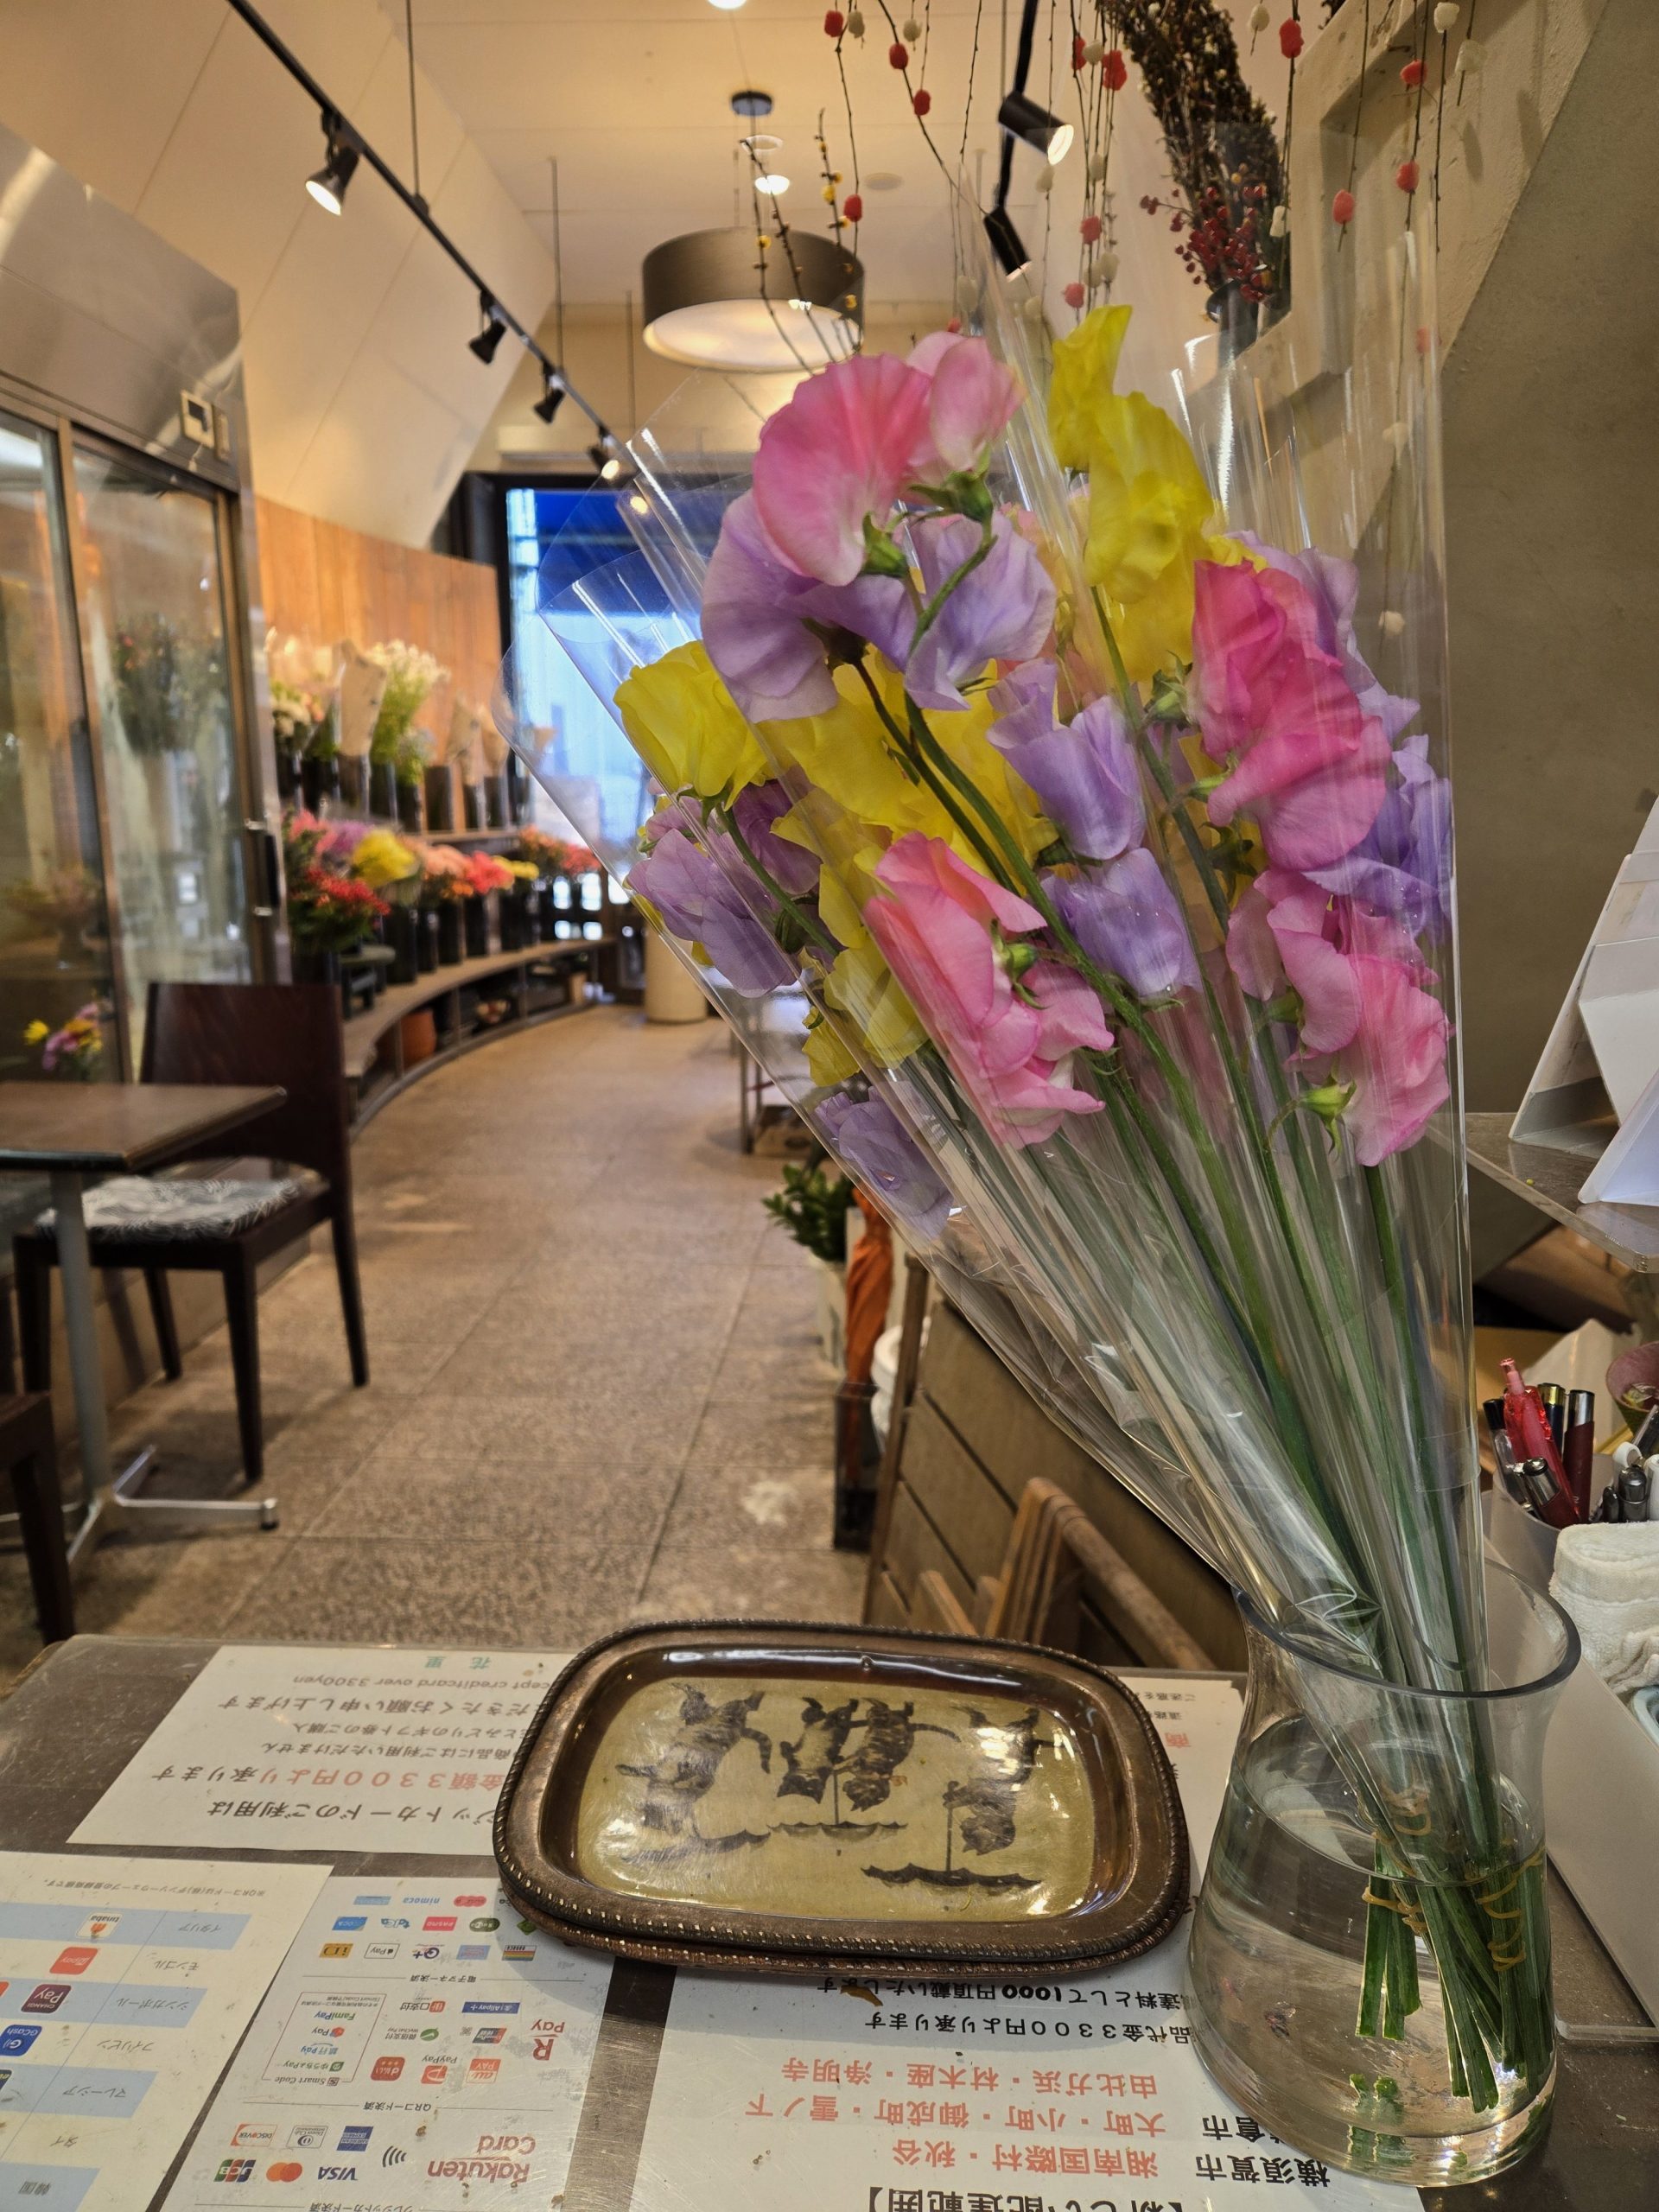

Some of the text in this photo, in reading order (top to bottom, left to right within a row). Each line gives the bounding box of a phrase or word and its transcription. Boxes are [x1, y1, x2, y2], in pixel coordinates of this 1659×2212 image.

[293, 1674, 370, 1688] 3300yen
[374, 1678, 413, 1688] over
[416, 1678, 508, 1690] creditcard
[218, 1695, 538, 1717] だきたくお願い申し上げます
[261, 1743, 518, 1760] 商品にはご利用いただけません
[403, 1897, 440, 1906] nimoca
[178, 1923, 221, 1933] イタリア
[370, 1947, 387, 1955] Pay
[154, 1961, 199, 1970] モンゴル
[410, 1974, 477, 1983] 電子マネー決済
[33, 1987, 64, 2004] Pay
[116, 1998, 189, 2011] シンガポール
[313, 2011, 356, 2021] FamiPay
[6, 2027, 38, 2037] GCash
[311, 2026, 330, 2037] Pay
[531, 2019, 565, 2033] Pay
[96, 2040, 155, 2053] フィリピン
[532, 2038, 554, 2061] R
[422, 2056, 458, 2064] PayPay
[475, 2062, 495, 2070] PAY
[61, 2086, 127, 2098] マレーシア
[363, 2101, 432, 2112] QRコード決済
[745, 2093, 1282, 2144] 倉市 大町・小町・御成町・雪ノ下
[49, 2135, 79, 2148] タイ
[476, 2135, 536, 2155] Card
[892, 2139, 1330, 2188] 横須賀市 湘南国際村・秋谷
[317, 2166, 358, 2181] VISA
[428, 2160, 531, 2183] Rakuten
